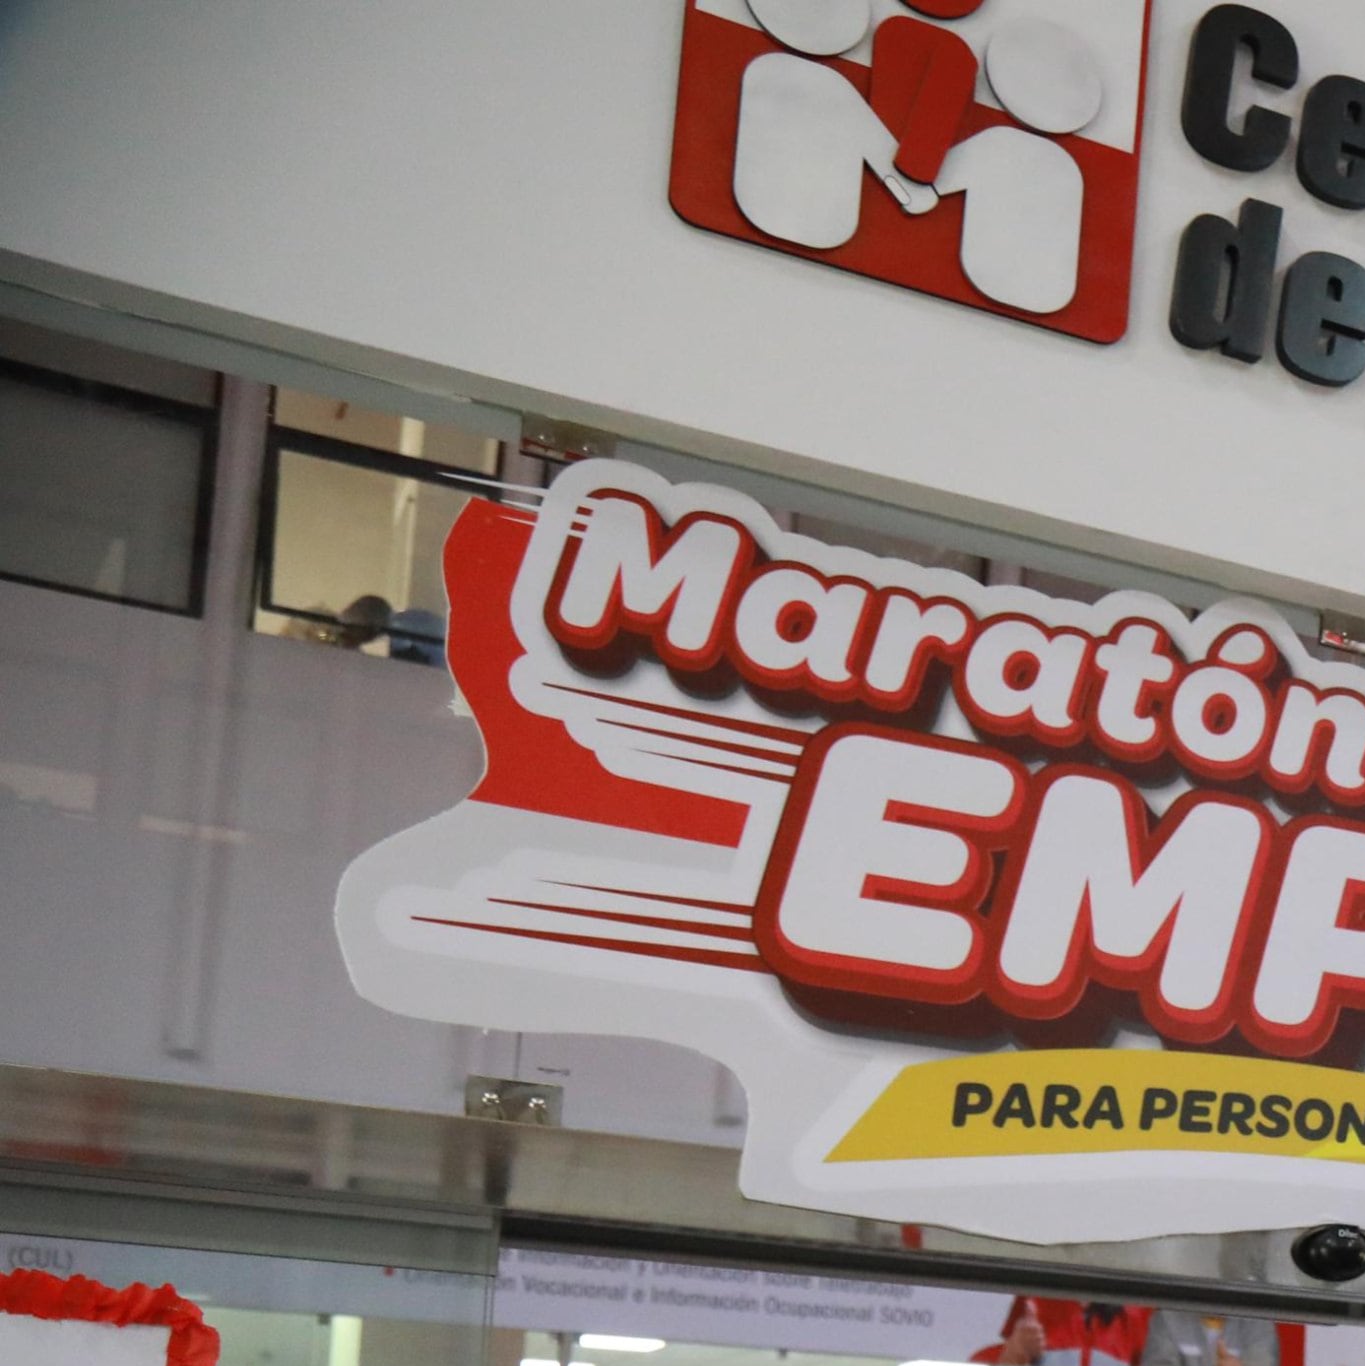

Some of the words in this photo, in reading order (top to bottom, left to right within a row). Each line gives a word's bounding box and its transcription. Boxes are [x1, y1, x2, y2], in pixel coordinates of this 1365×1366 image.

[951, 1082, 1125, 1130] PARA
[7, 1245, 74, 1272] (CUL)
[650, 1285, 758, 1311] Información
[763, 1297, 874, 1323] Ocupacional
